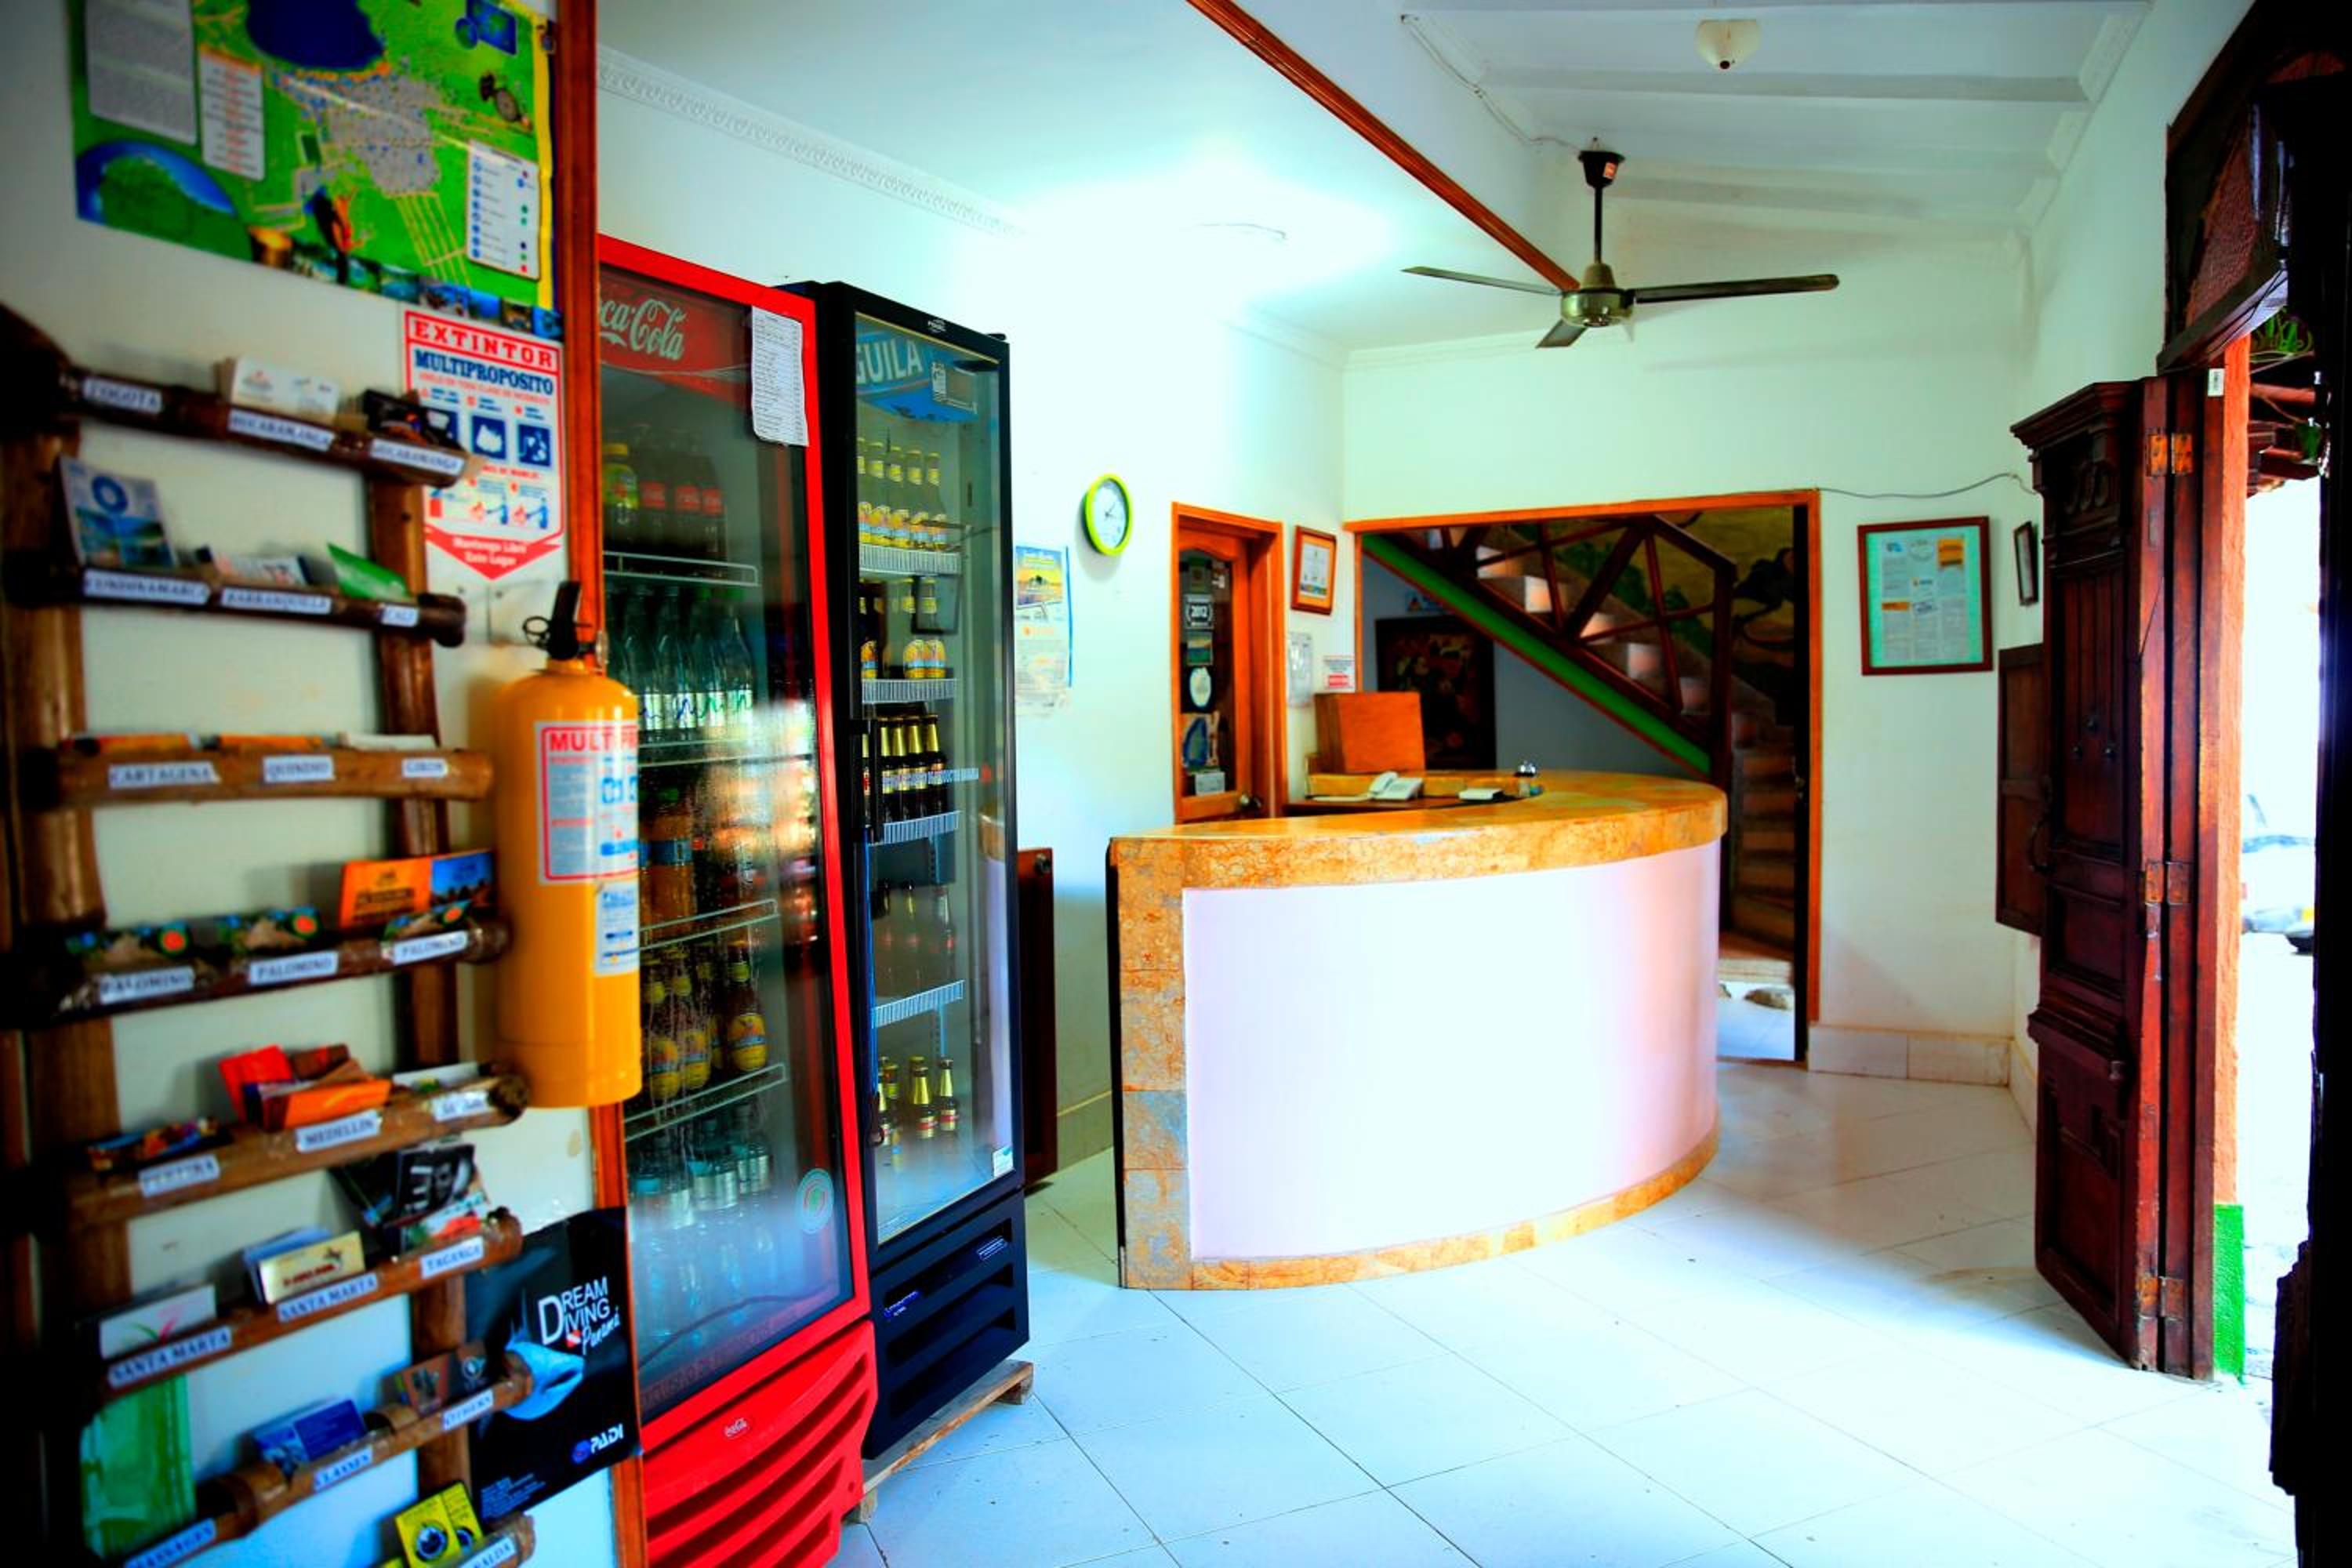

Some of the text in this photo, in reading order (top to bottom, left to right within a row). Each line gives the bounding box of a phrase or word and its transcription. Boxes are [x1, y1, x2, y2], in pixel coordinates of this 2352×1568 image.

[413, 319, 553, 368] EXTINTOR
[414, 348, 554, 396] MULTIPROPOSITO
[328, 1275, 376, 1301] MARTA
[172, 1331, 228, 1359] MARTA
[590, 1423, 624, 1454] PADI
